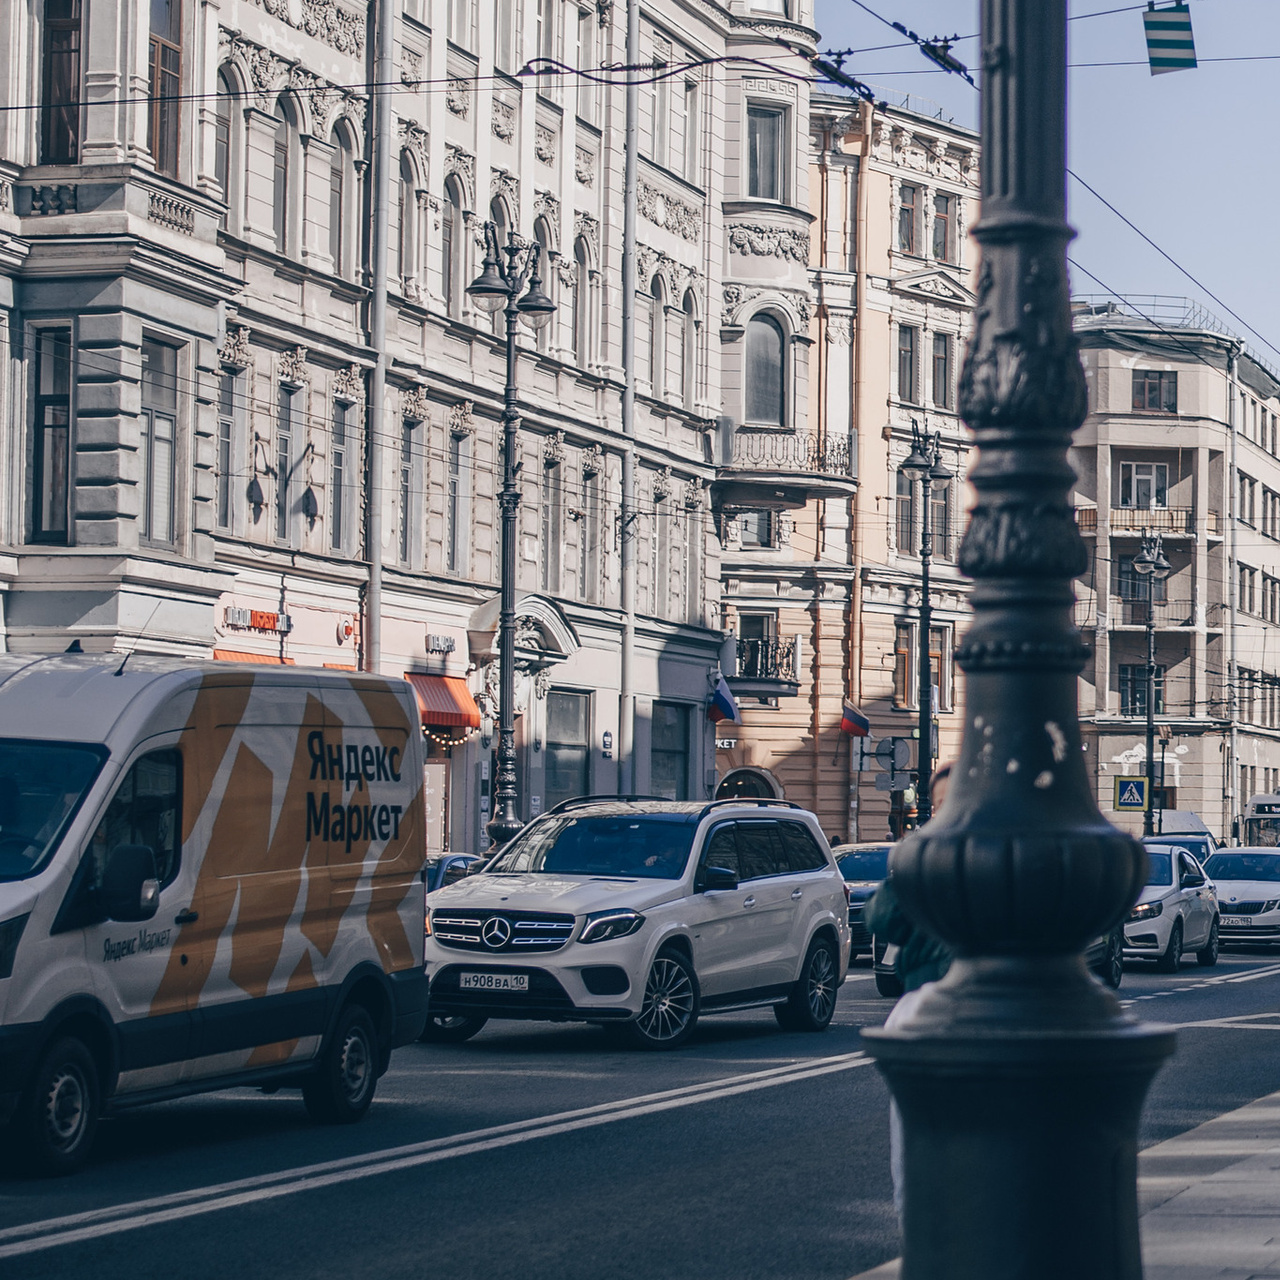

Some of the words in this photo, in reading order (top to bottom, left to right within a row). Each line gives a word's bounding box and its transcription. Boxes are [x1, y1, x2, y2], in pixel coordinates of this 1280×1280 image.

[307, 730, 401, 791] Яндекс
[306, 791, 402, 854] Маркет
[103, 937, 137, 962] Яндекс
[138, 928, 172, 954] Маркет
